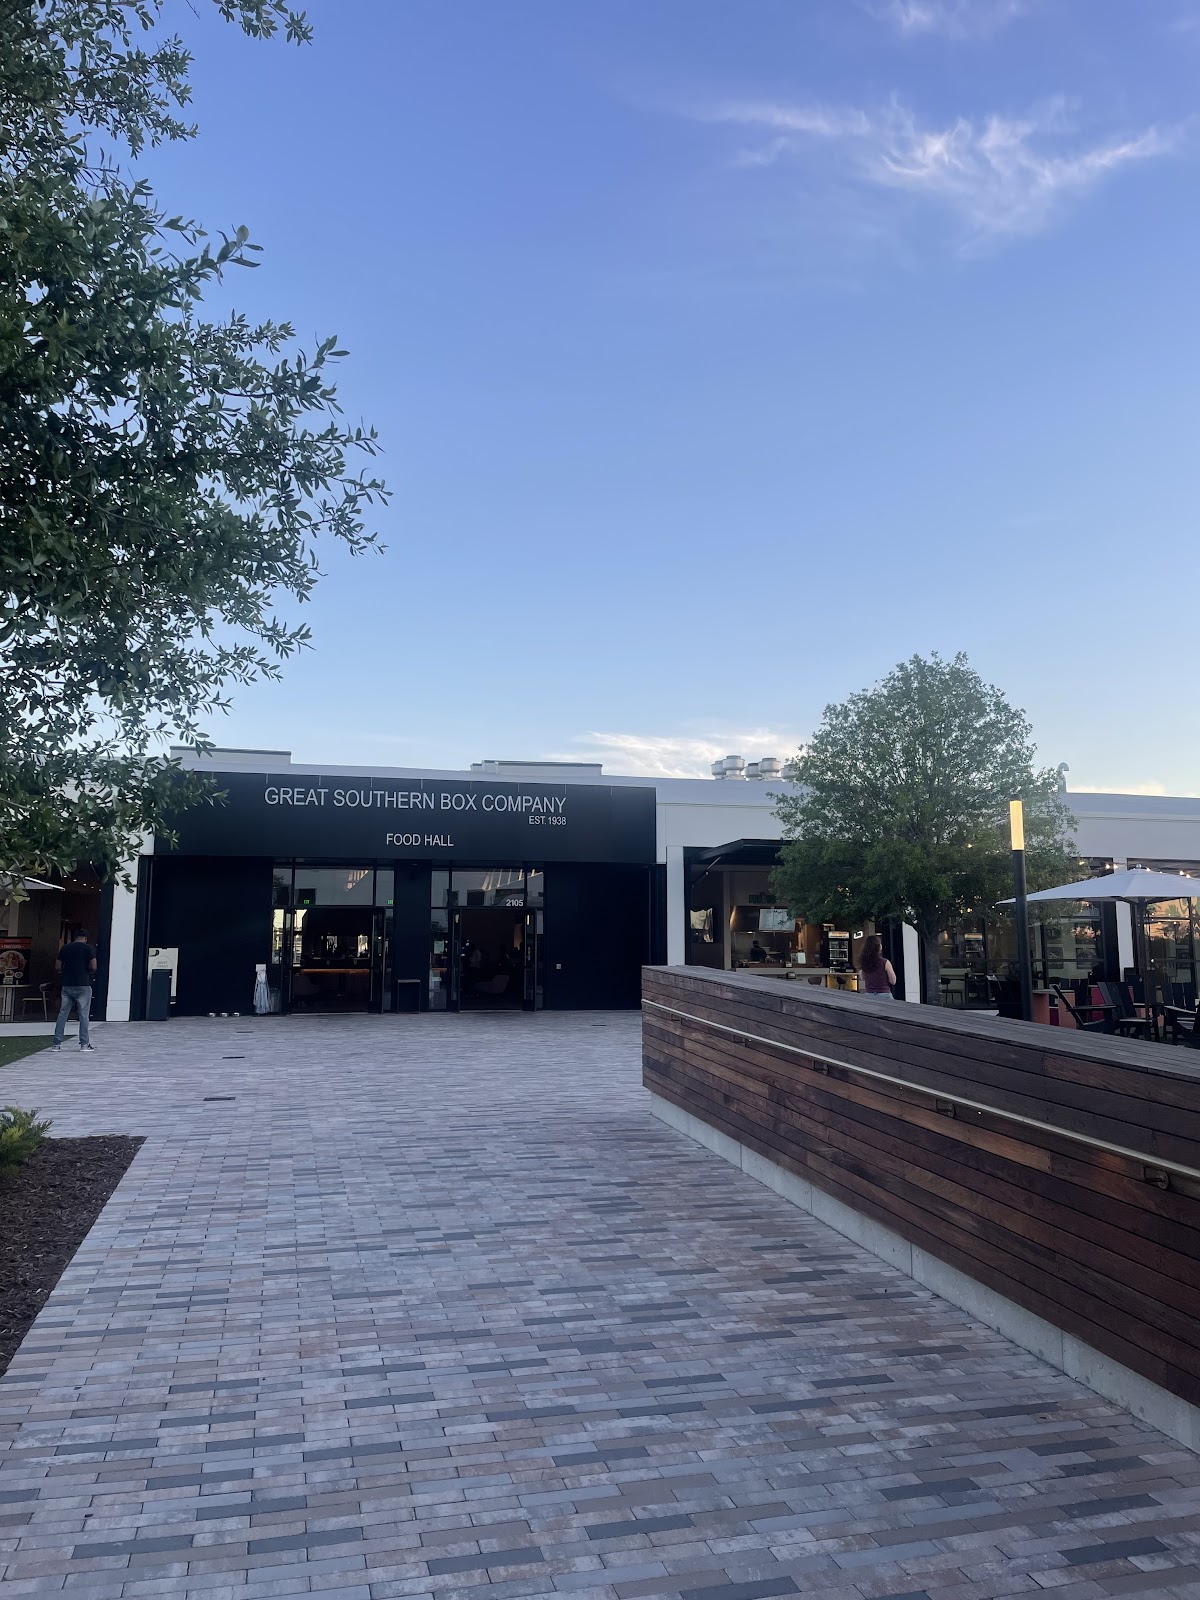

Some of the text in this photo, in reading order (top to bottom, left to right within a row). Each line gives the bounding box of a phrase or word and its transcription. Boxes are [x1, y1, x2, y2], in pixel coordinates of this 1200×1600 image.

[264, 786, 567, 814] GREAT SOUTHERN BOX COMPANY
[548, 816, 567, 826] 1938
[386, 833, 454, 847] FOOD HALL
[505, 899, 524, 907] 2105
